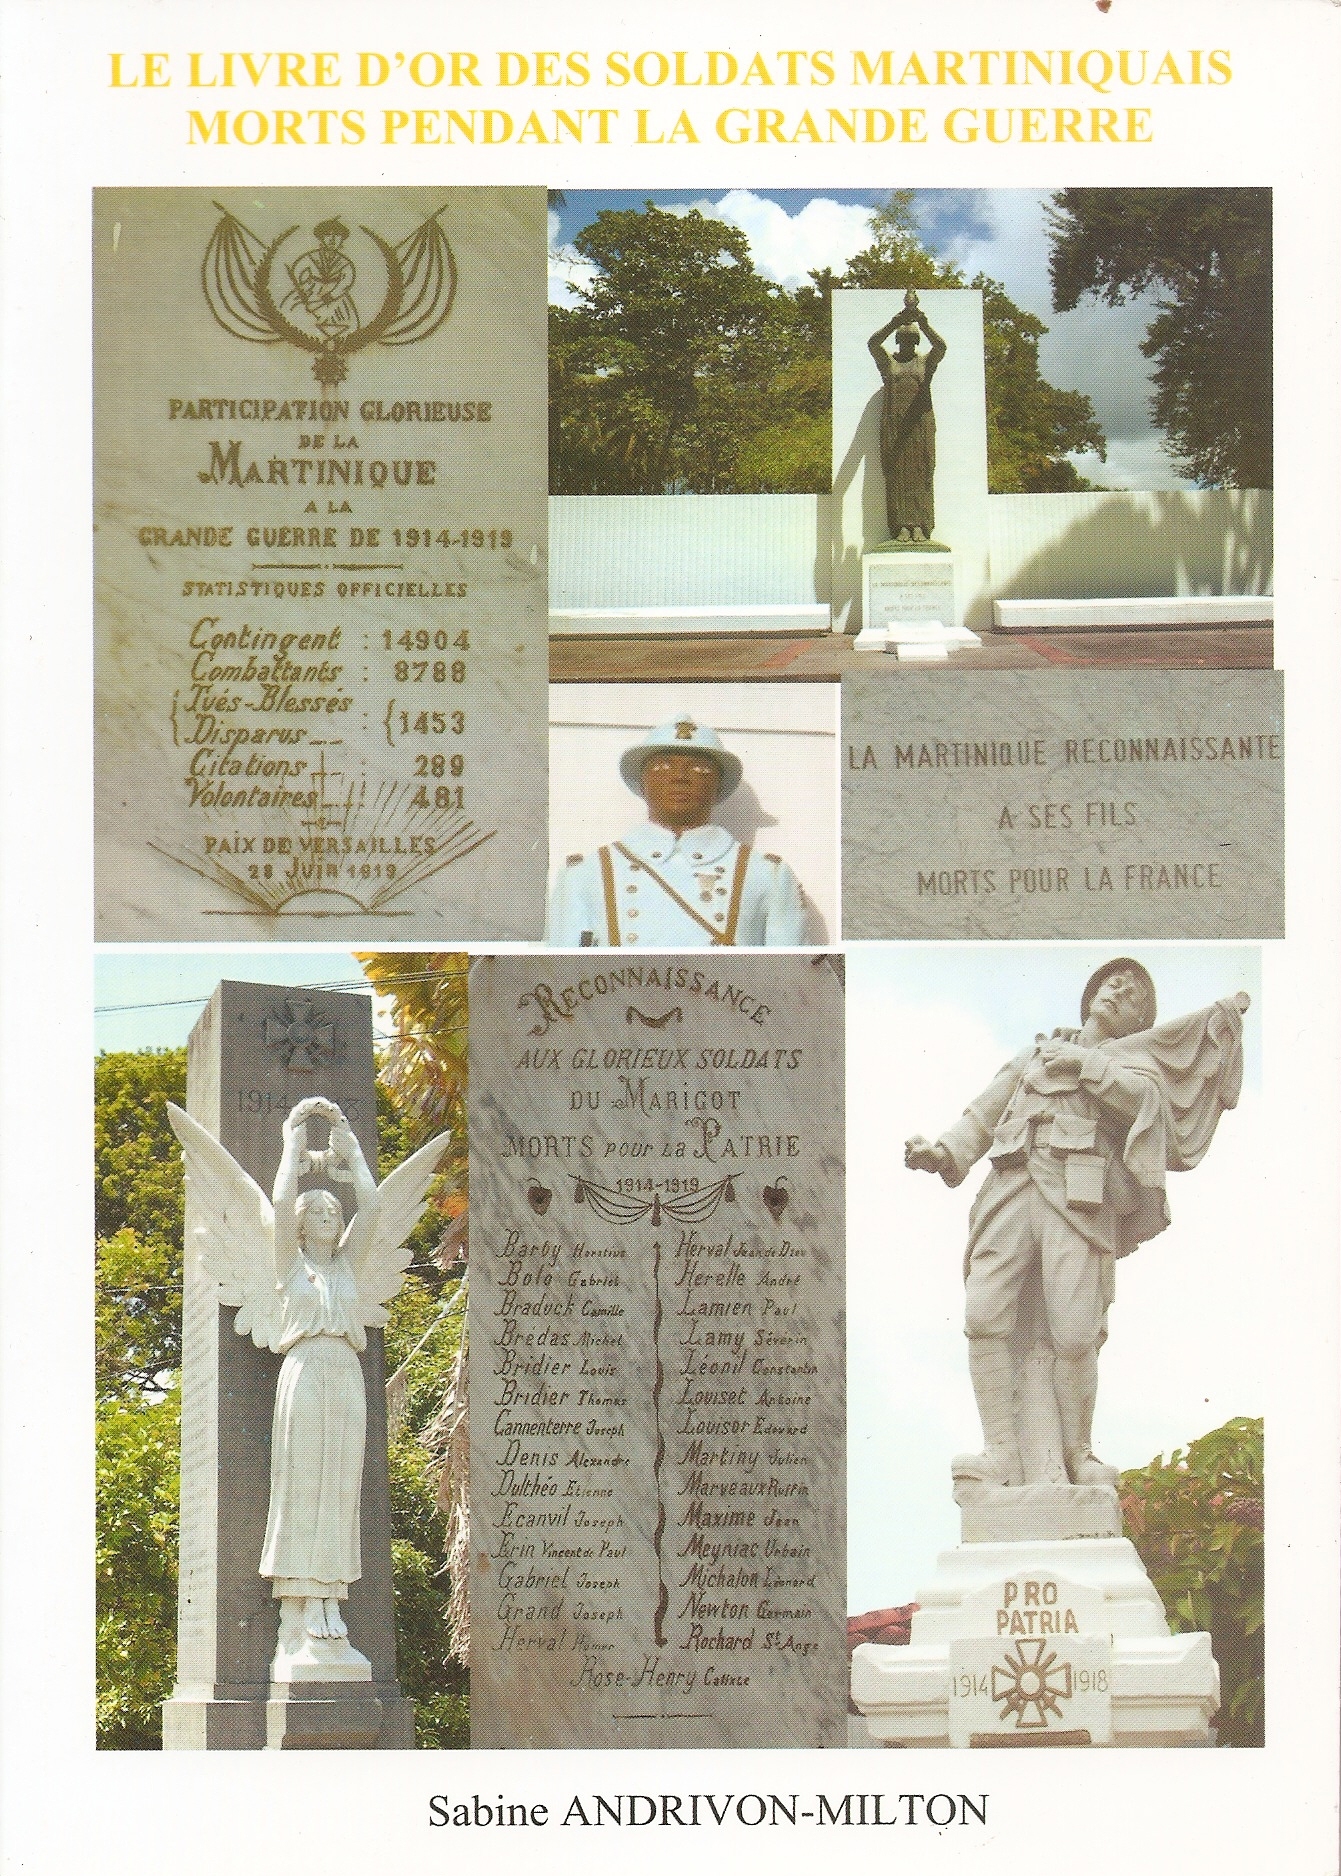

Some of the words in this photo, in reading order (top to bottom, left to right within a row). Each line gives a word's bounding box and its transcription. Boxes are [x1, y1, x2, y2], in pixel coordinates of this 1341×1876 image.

[107, 52, 172, 88] LE
[186, 52, 342, 88] LIVRE
[356, 51, 482, 88] D'OR
[496, 51, 591, 87] DES
[605, 50, 836, 87] SOLDATS
[849, 49, 1233, 93] MARTINIQUAIS
[185, 109, 366, 145] MORTS
[379, 109, 618, 145] PENDANT
[633, 109, 700, 145] LA
[714, 107, 928, 143] GRANDE
[943, 107, 1153, 143] GUERRE
[168, 398, 349, 422] PARTICIPATION
[360, 401, 492, 422] GLORIEUSE
[298, 434, 326, 450] DE
[334, 435, 359, 450] LA
[304, 501, 318, 514] A
[327, 501, 353, 514] LA
[137, 526, 233, 548] GRANDE
[247, 527, 337, 548] GUERRE
[350, 528, 379, 547] DE
[393, 529, 513, 549] 1914-1919
[182, 581, 324, 598] STATISTIQUES
[337, 581, 468, 598] OFFICIELLES
[188, 616, 340, 656] Contingent
[382, 628, 471, 651] 14904
[190, 652, 343, 683] Combattants
[394, 661, 467, 683] 8788
[184, 684, 353, 713] Tués-Blessés
[184, 715, 308, 755] Disparus
[399, 710, 466, 735] 1453
[188, 748, 309, 778] Citations
[415, 755, 464, 777] 289
[848, 745, 877, 770] LA
[896, 740, 1046, 768] MARTINIQUE
[1065, 735, 1282, 764] RECONNAISSANTE
[184, 777, 318, 809] Volontaires
[411, 786, 466, 809] 481
[999, 806, 1015, 830] A
[1029, 804, 1073, 828] SES
[1086, 802, 1138, 827] FILS
[263, 836, 292, 854] DE
[300, 836, 437, 855] VERSAILLES
[248, 864, 274, 879] 28
[918, 869, 996, 896] MORTS
[1010, 867, 1070, 893] POUR
[1085, 866, 1113, 891] LA
[1125, 863, 1222, 890] FRANCE
[517, 1048, 563, 1069] AUX
[572, 1048, 688, 1070] GLORIEUX
[696, 1048, 803, 1070] SOLDATS
[570, 1090, 601, 1110] DU
[502, 1135, 594, 1158] MORTS
[603, 1140, 653, 1158] pour
[686, 1116, 801, 1163] PATRIE
[616, 1179, 700, 1194] 1914-1919
[675, 1230, 733, 1259] Herval
[680, 1318, 745, 1355] Lamy
[493, 1348, 571, 1376] Bridier
[579, 1360, 617, 1376] Louis
[494, 1378, 569, 1406] Bridier
[586, 1419, 625, 1438] Joseph
[495, 1438, 559, 1466] Denis
[678, 1440, 760, 1474] Martiny
[574, 1511, 625, 1533] Joseph
[678, 1501, 755, 1529] Maxime
[498, 1561, 570, 1590] Gabriel
[497, 1592, 564, 1621] Grand
[573, 1602, 624, 1623] Joseph
[678, 1589, 749, 1620] Newton
[1004, 1582, 1058, 1608] PRO
[996, 1609, 1079, 1635] PATRIA
[953, 1674, 990, 1698] 1914
[1073, 1670, 1108, 1692] 1918
[429, 1794, 548, 1827] Sabine
[560, 1794, 989, 1827] ANDRIVON-MILTON
